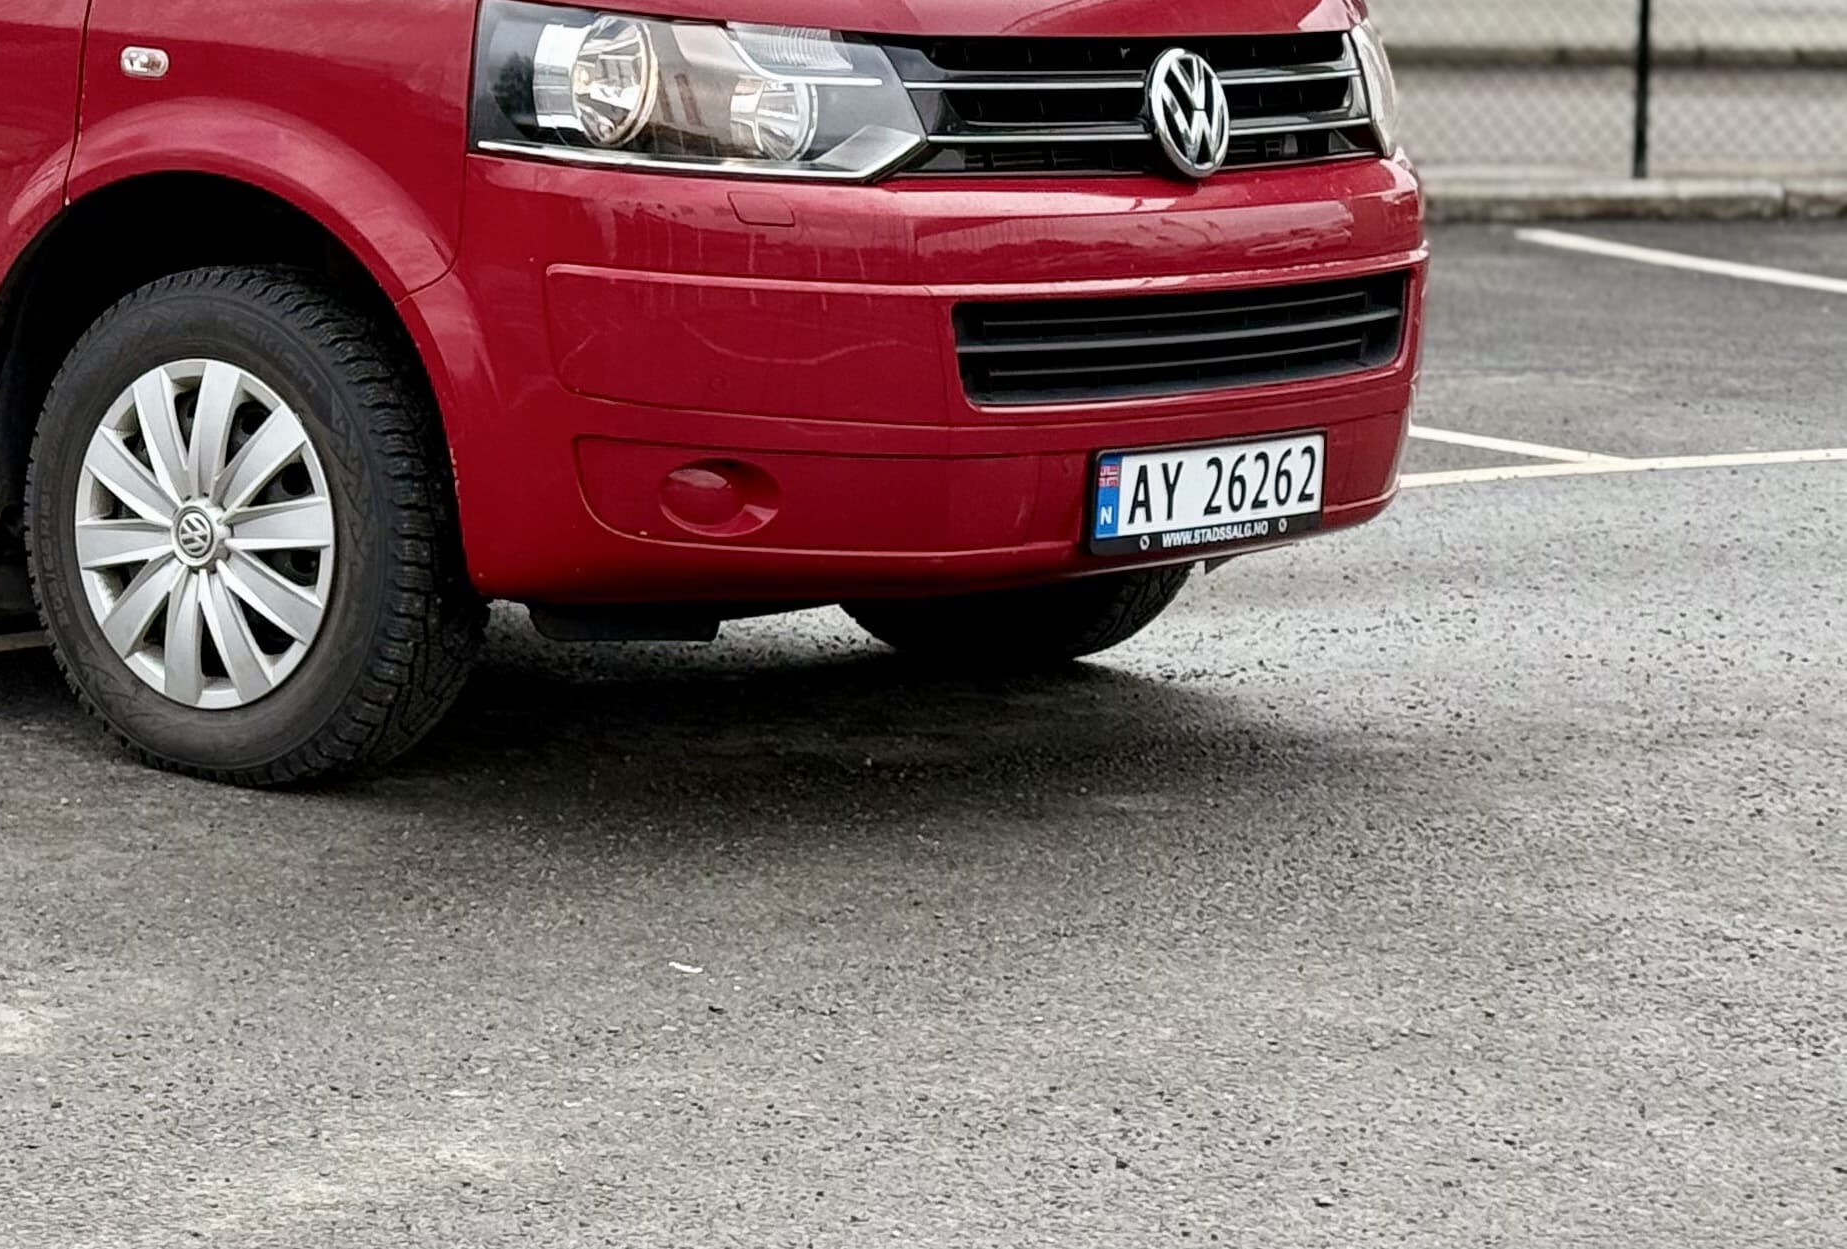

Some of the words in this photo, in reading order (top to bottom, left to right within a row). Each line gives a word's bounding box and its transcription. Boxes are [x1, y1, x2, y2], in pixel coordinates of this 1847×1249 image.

[1127, 461, 1184, 525] AY
[1203, 446, 1316, 516] 26262
[1099, 505, 1113, 526] N
[1161, 520, 1269, 548] WWW.STADSSALG.NO
